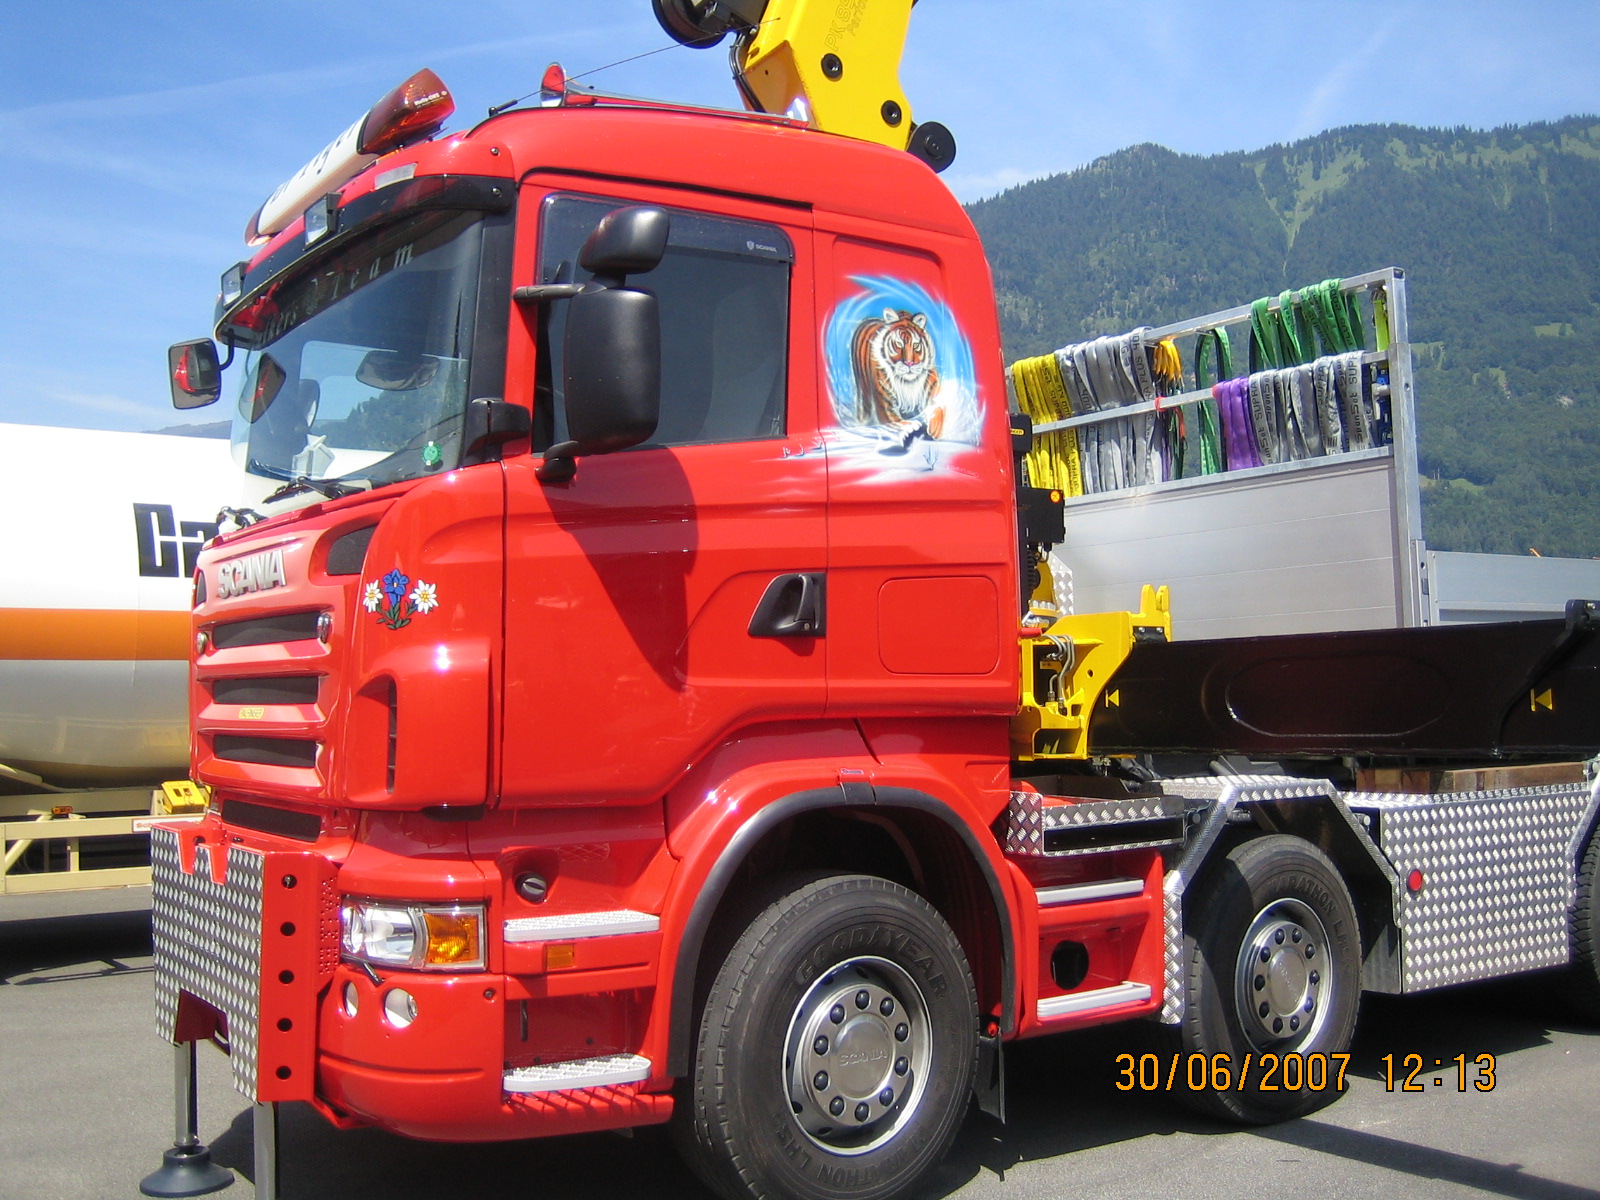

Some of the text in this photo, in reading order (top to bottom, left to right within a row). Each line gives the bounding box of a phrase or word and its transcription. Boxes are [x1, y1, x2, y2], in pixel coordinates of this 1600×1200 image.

[755, 243, 777, 253] SCANIA
[1136, 356, 1147, 384] PLUS
[1250, 381, 1263, 421] SUPRA
[1348, 352, 1363, 444] SpanSet SUPR
[217, 549, 287, 599] SCANIA
[796, 925, 948, 1001] GOODYEAR
